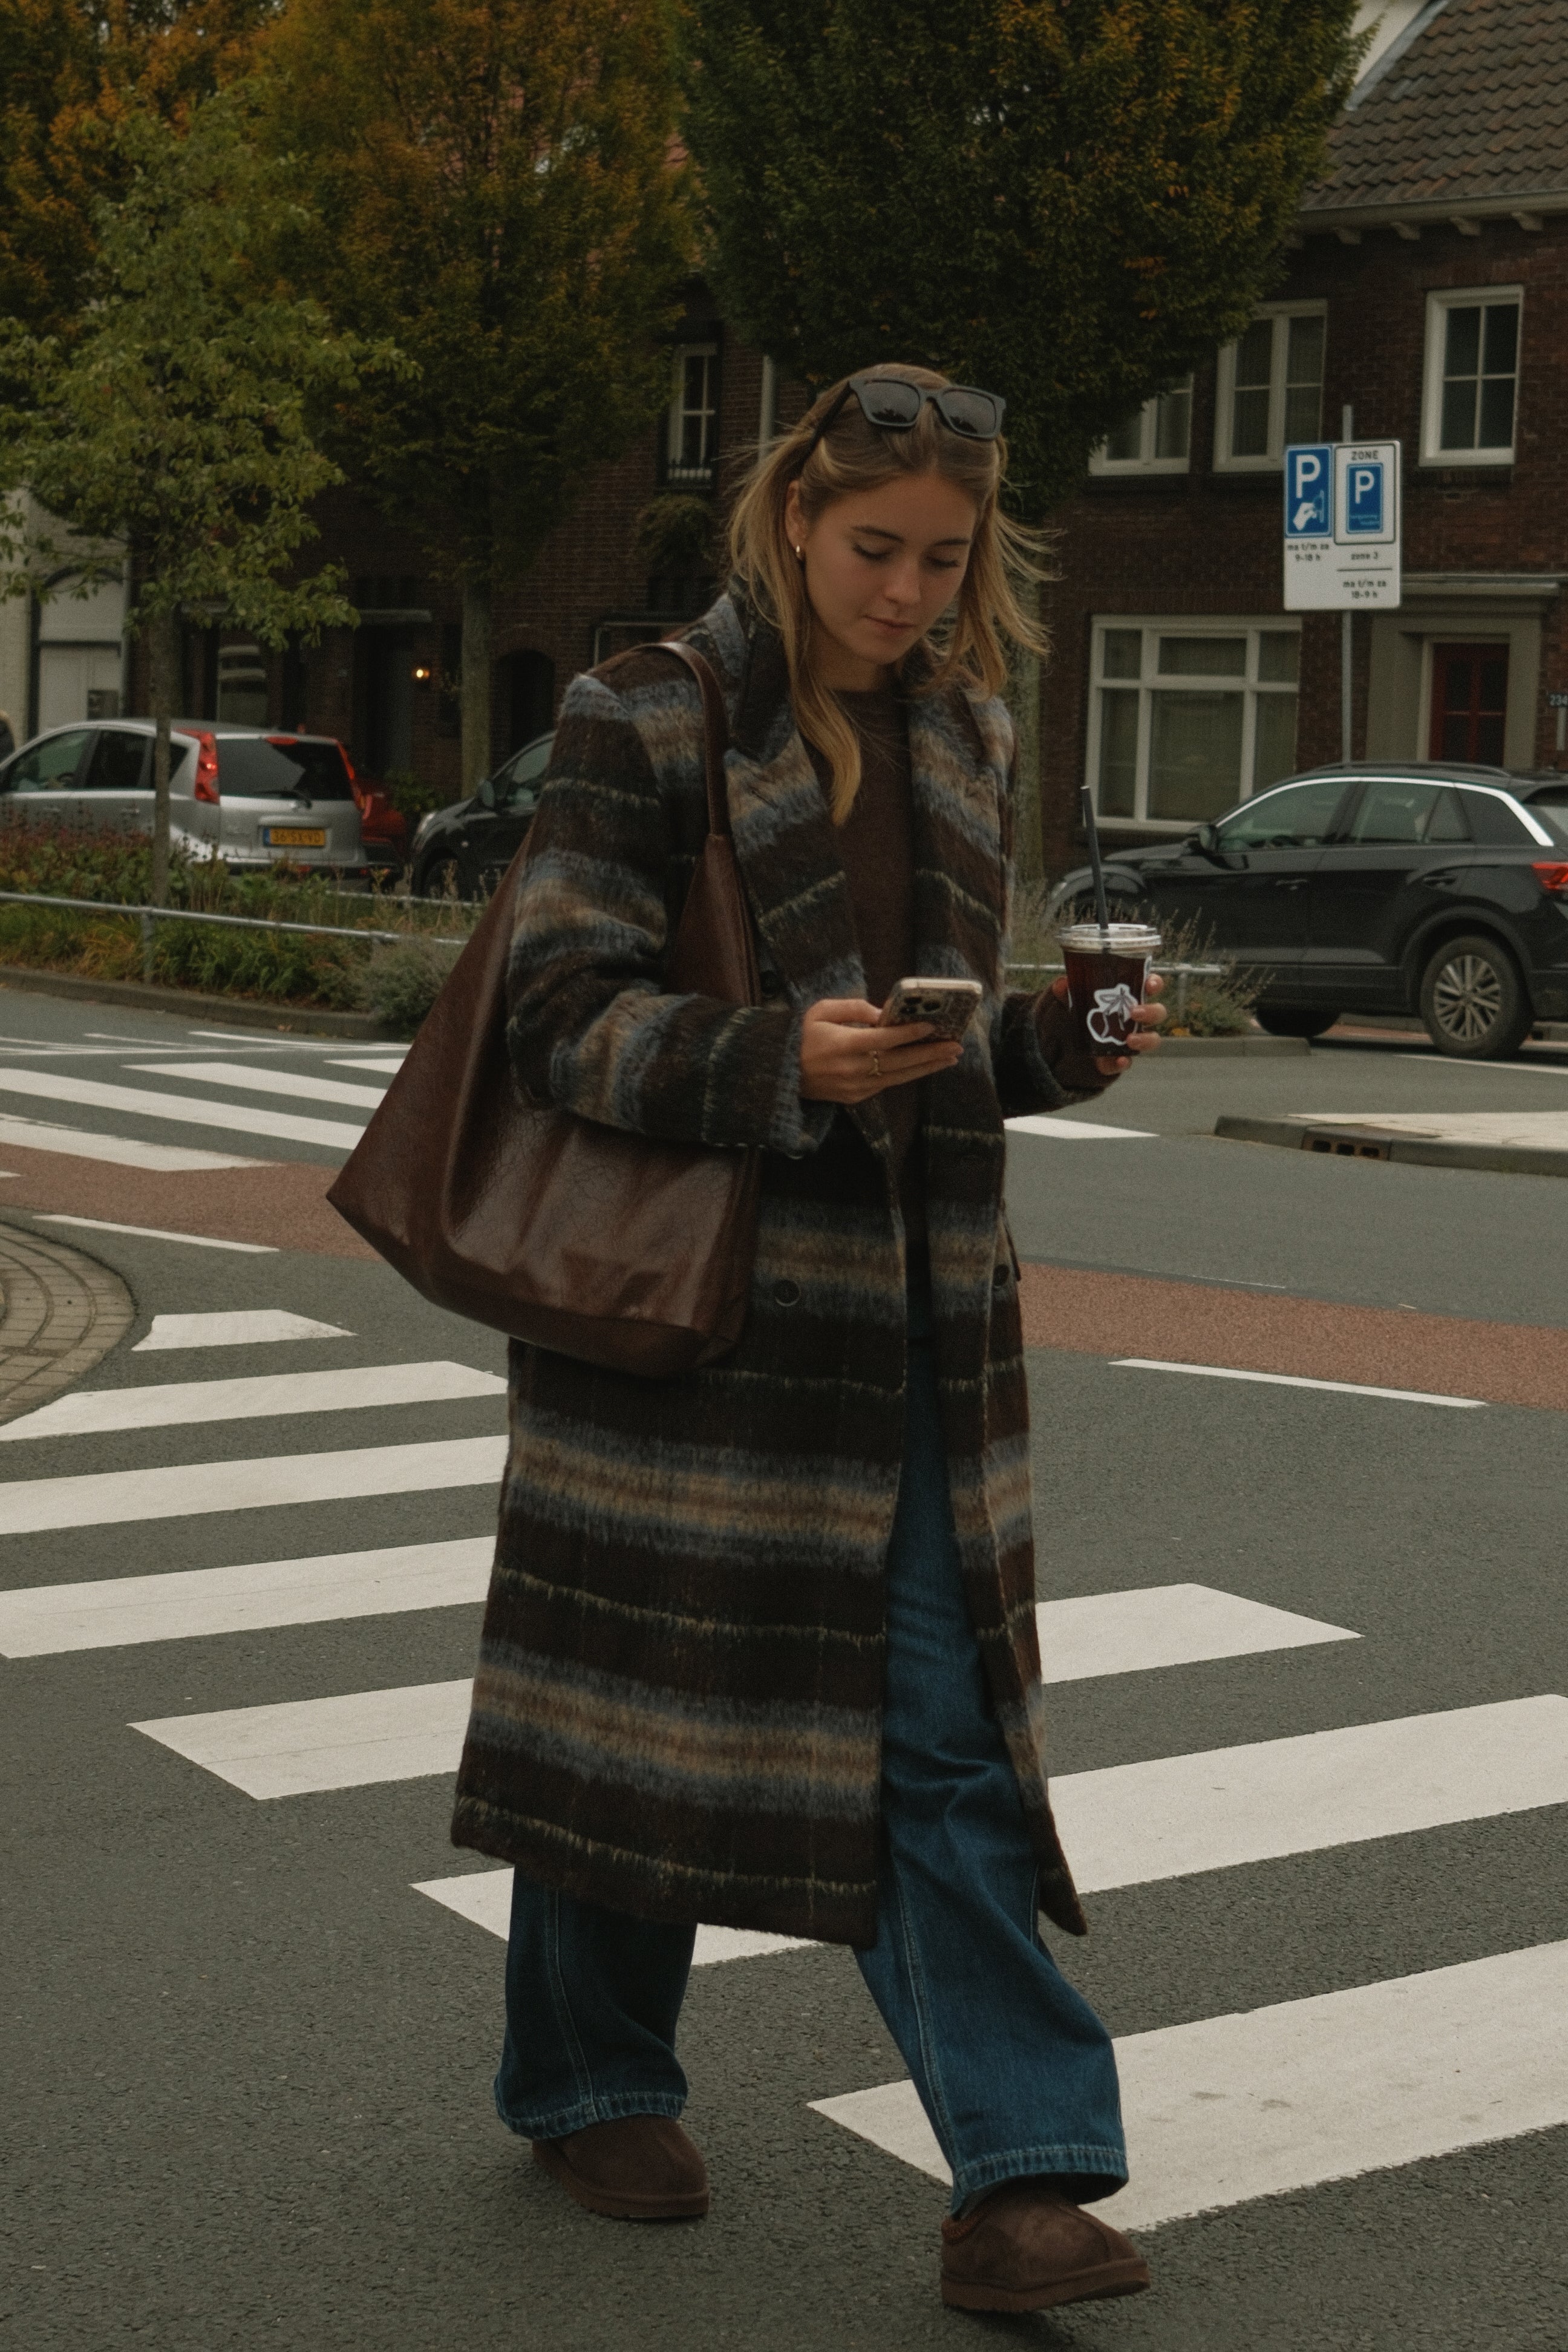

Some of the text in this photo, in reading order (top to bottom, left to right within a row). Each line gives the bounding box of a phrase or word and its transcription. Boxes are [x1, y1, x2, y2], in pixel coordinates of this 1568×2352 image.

[1351, 450, 1379, 460] ZONE
[1296, 454, 1321, 498] P
[1355, 470, 1375, 504] P
